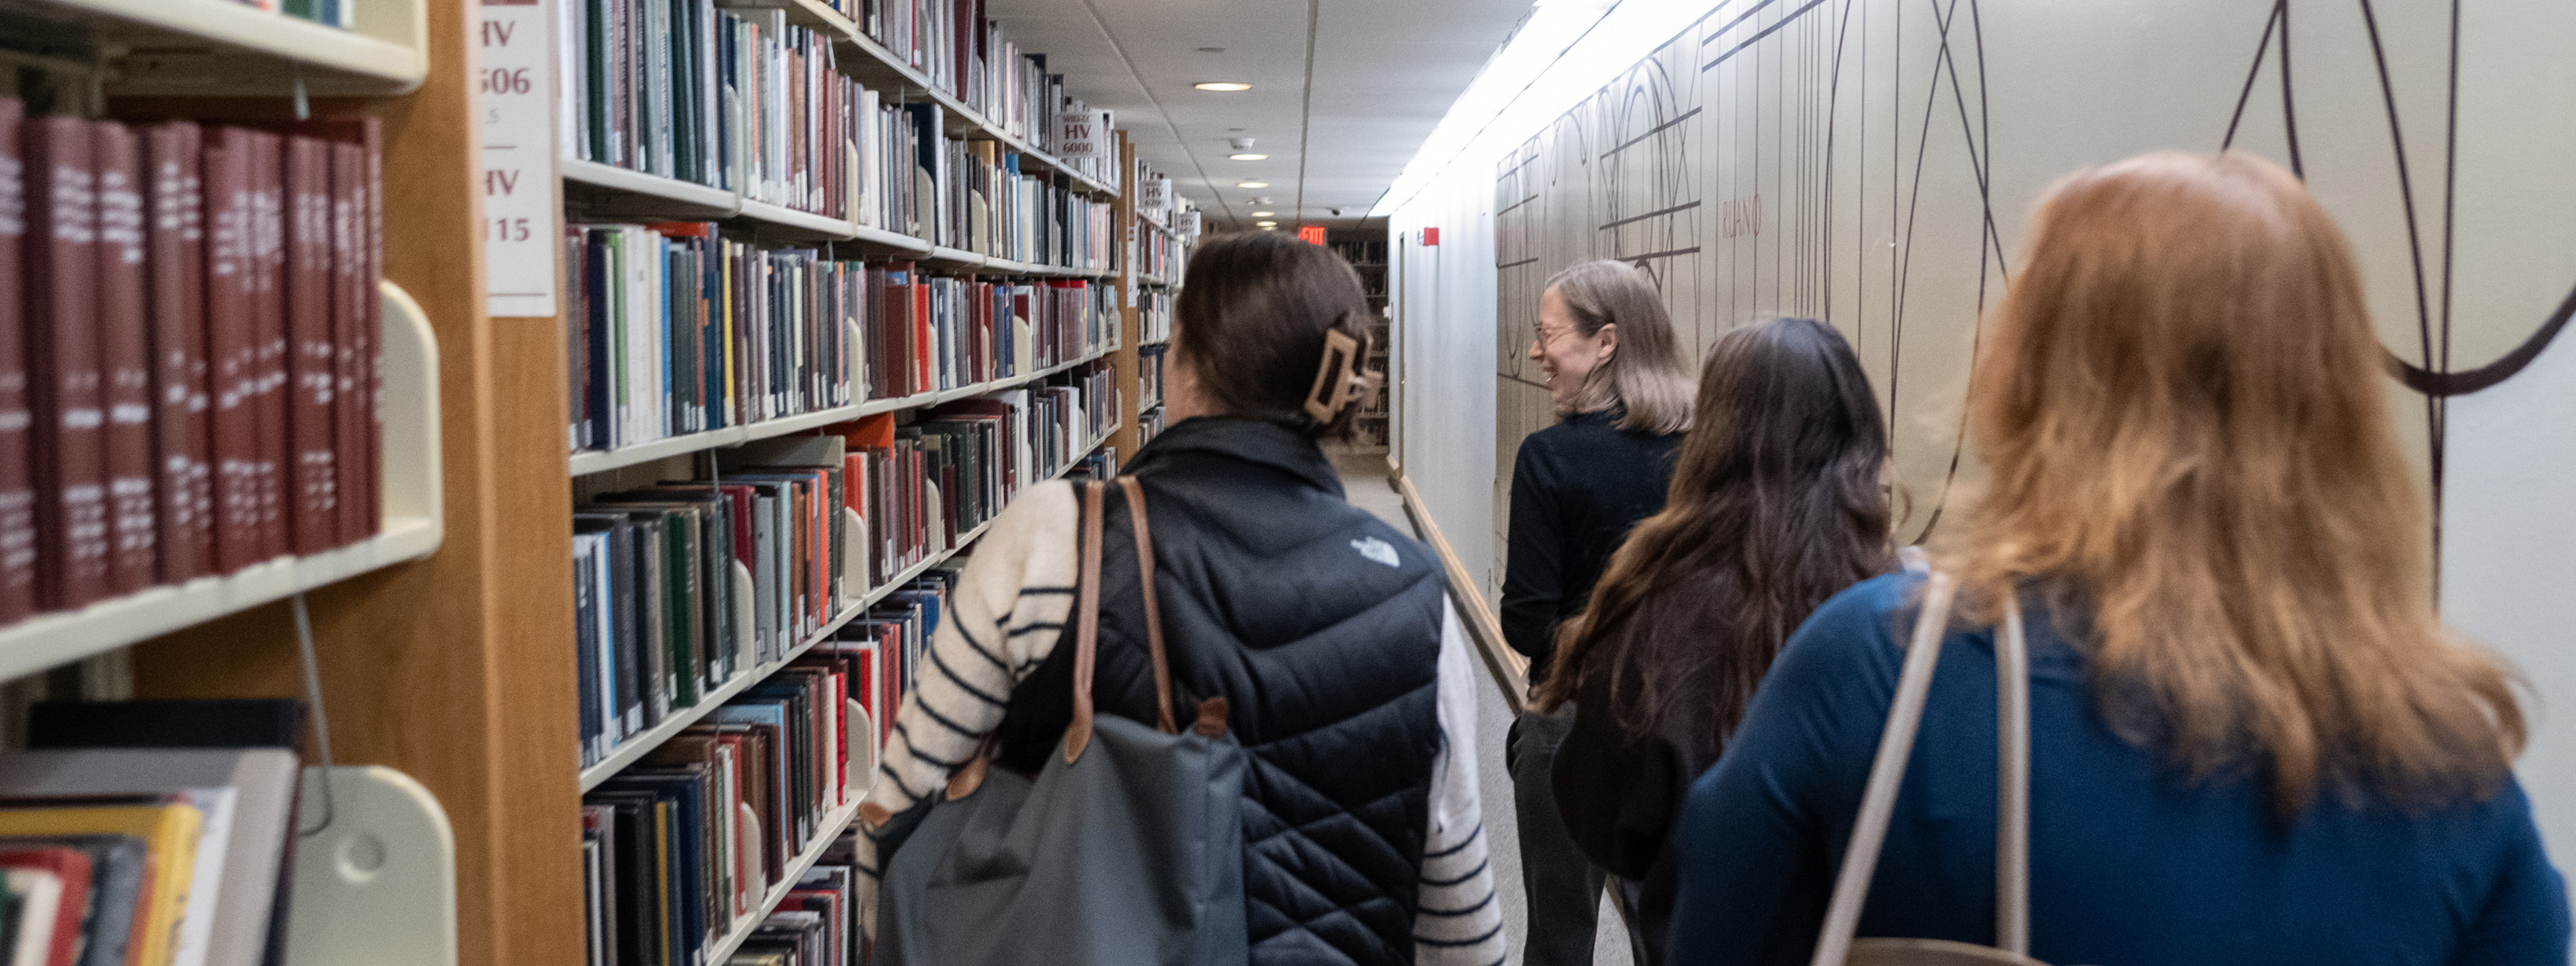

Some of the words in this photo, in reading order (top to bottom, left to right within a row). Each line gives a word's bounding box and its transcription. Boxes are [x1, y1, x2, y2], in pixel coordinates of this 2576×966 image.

[1065, 124, 1092, 140] HV
[1063, 142, 1093, 153] 6000
[1146, 187, 1164, 198] HV
[1302, 226, 1325, 246] EXIT
